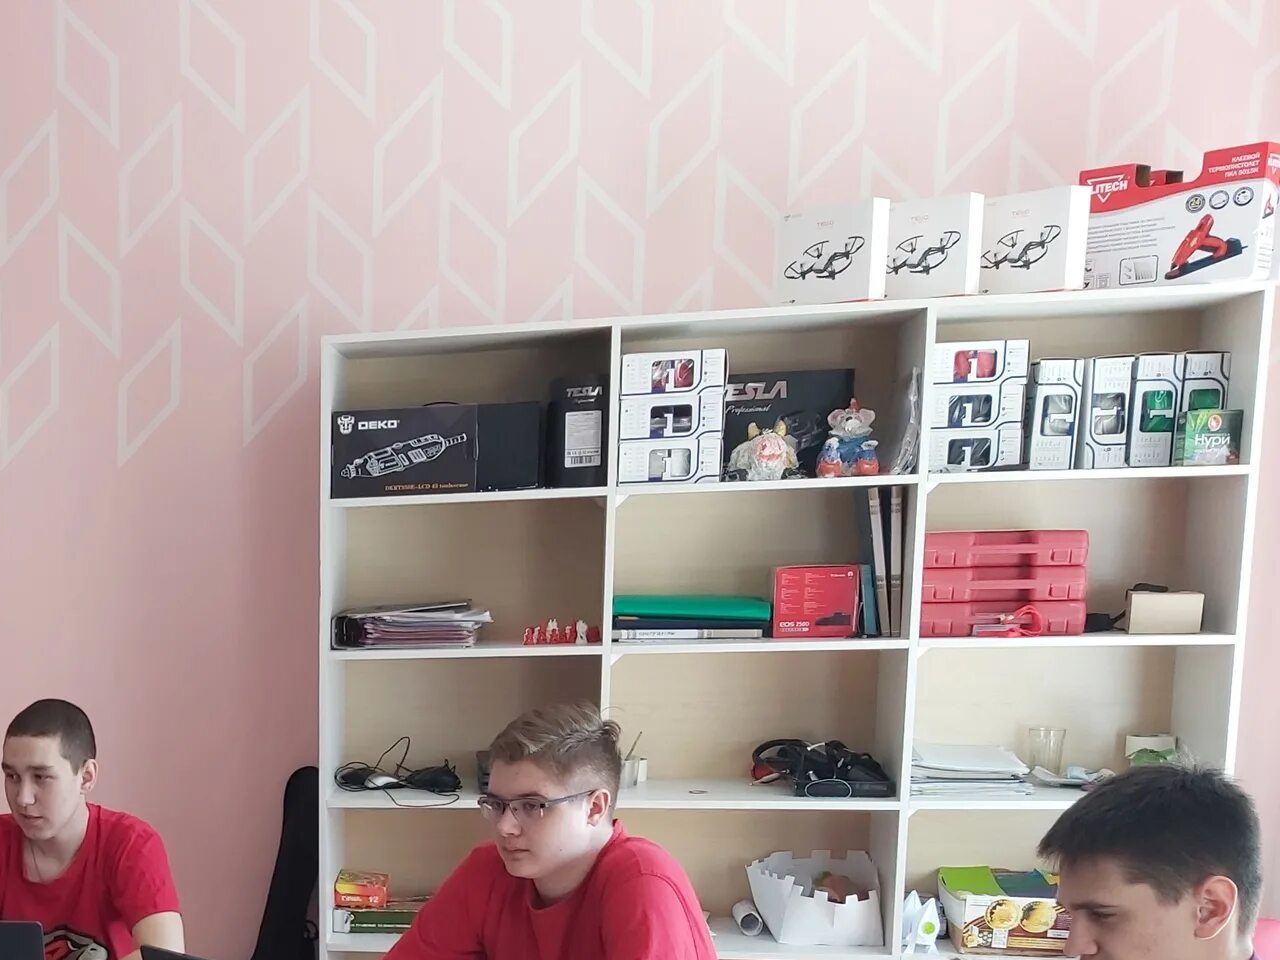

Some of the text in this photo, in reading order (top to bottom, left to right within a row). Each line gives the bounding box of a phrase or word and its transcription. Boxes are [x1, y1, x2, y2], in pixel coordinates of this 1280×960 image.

[1091, 179, 1129, 194] LITECH
[566, 386, 603, 398] TESLA
[724, 380, 788, 402] ESLA
[358, 419, 399, 430] DEKO
[1194, 433, 1231, 448] Нури
